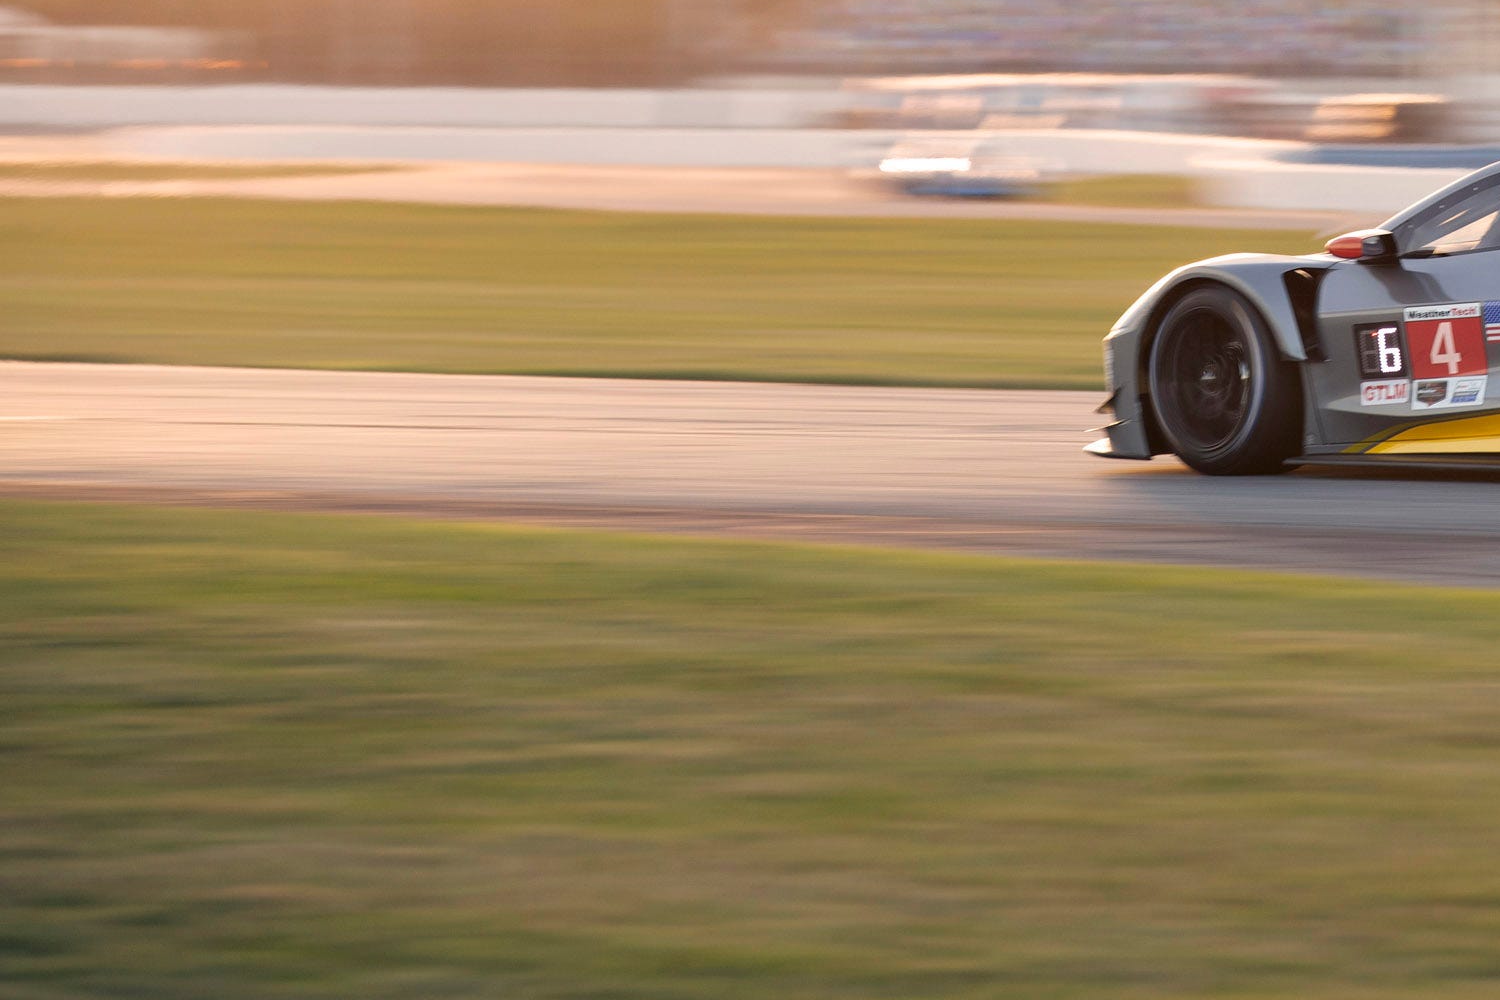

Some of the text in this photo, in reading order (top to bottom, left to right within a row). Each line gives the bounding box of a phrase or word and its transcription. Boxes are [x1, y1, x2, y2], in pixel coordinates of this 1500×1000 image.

[1408, 307, 1477, 319] WeatherTech
[1377, 327, 1402, 373] 6
[1430, 321, 1462, 375] 4
[1364, 383, 1407, 401] GTLM
